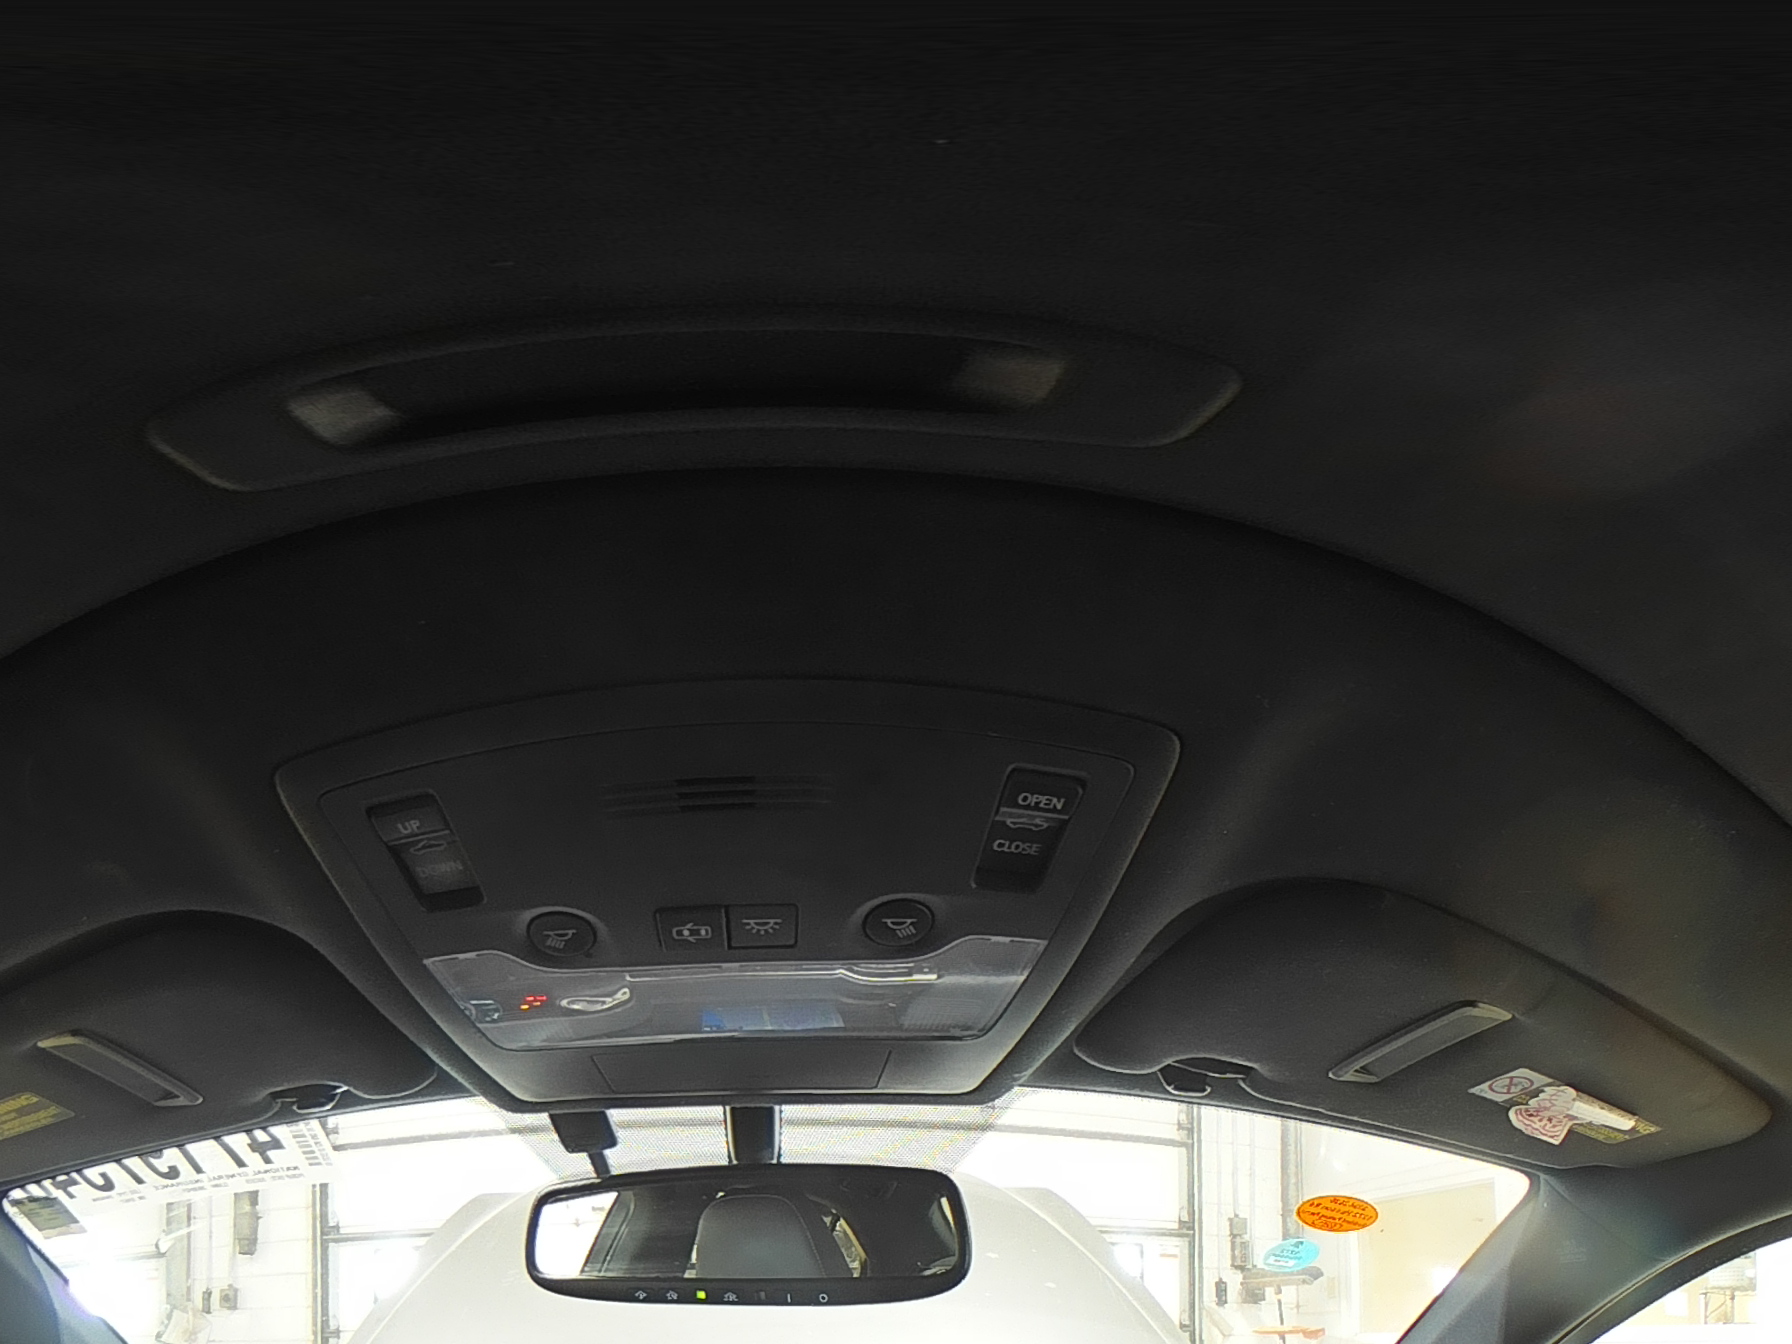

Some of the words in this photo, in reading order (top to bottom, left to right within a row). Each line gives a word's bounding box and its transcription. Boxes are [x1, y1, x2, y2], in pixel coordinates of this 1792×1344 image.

[1017, 792, 1066, 810] OPEN
[397, 819, 421, 834] UP
[992, 839, 1042, 855] CLOSE
[415, 861, 463, 877] DOWN
